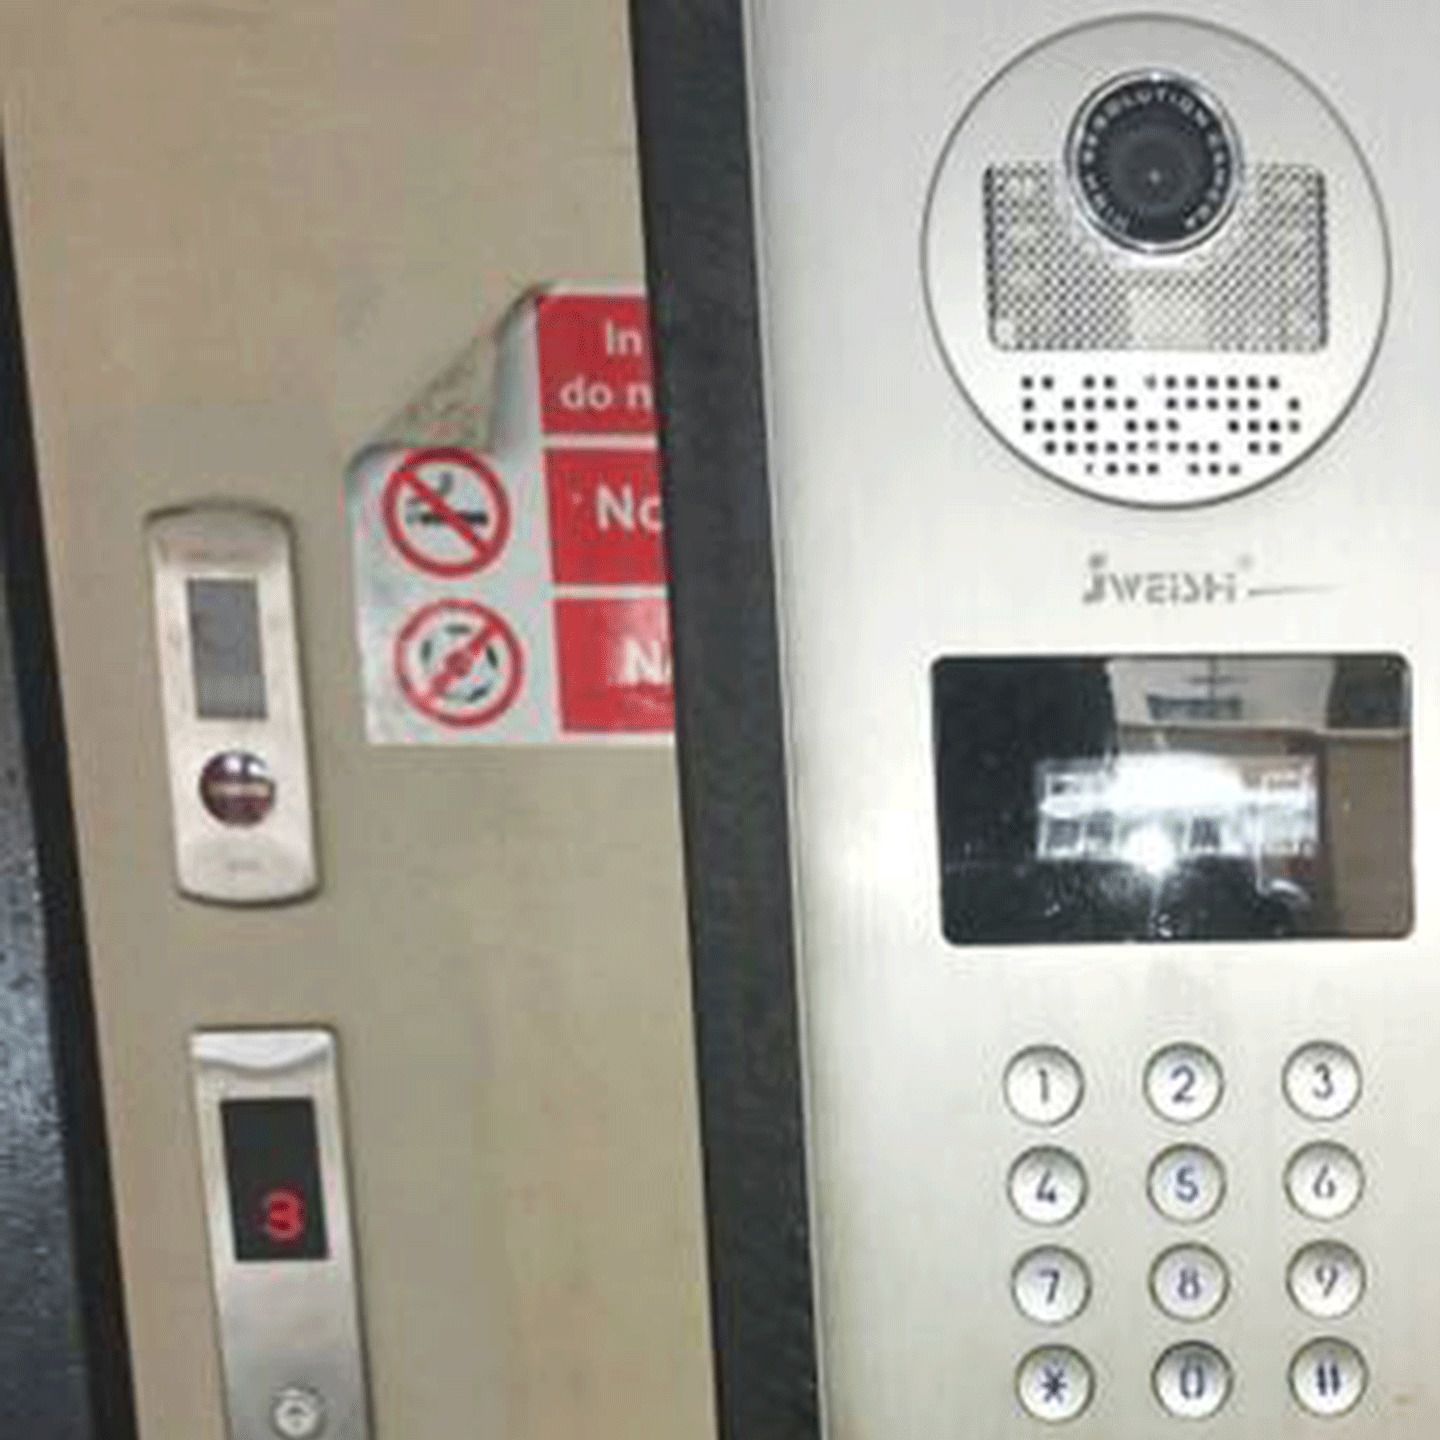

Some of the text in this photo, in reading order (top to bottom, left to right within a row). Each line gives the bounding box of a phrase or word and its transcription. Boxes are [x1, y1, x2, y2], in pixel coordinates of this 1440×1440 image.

[606, 320, 642, 355] In
[561, 376, 613, 409] do
[1036, 1062, 1335, 1103] 1 2 3
[1036, 1163, 1336, 1203] 4 5 6
[266, 1189, 303, 1240] 3
[1038, 1263, 1339, 1304] 7 8 9
